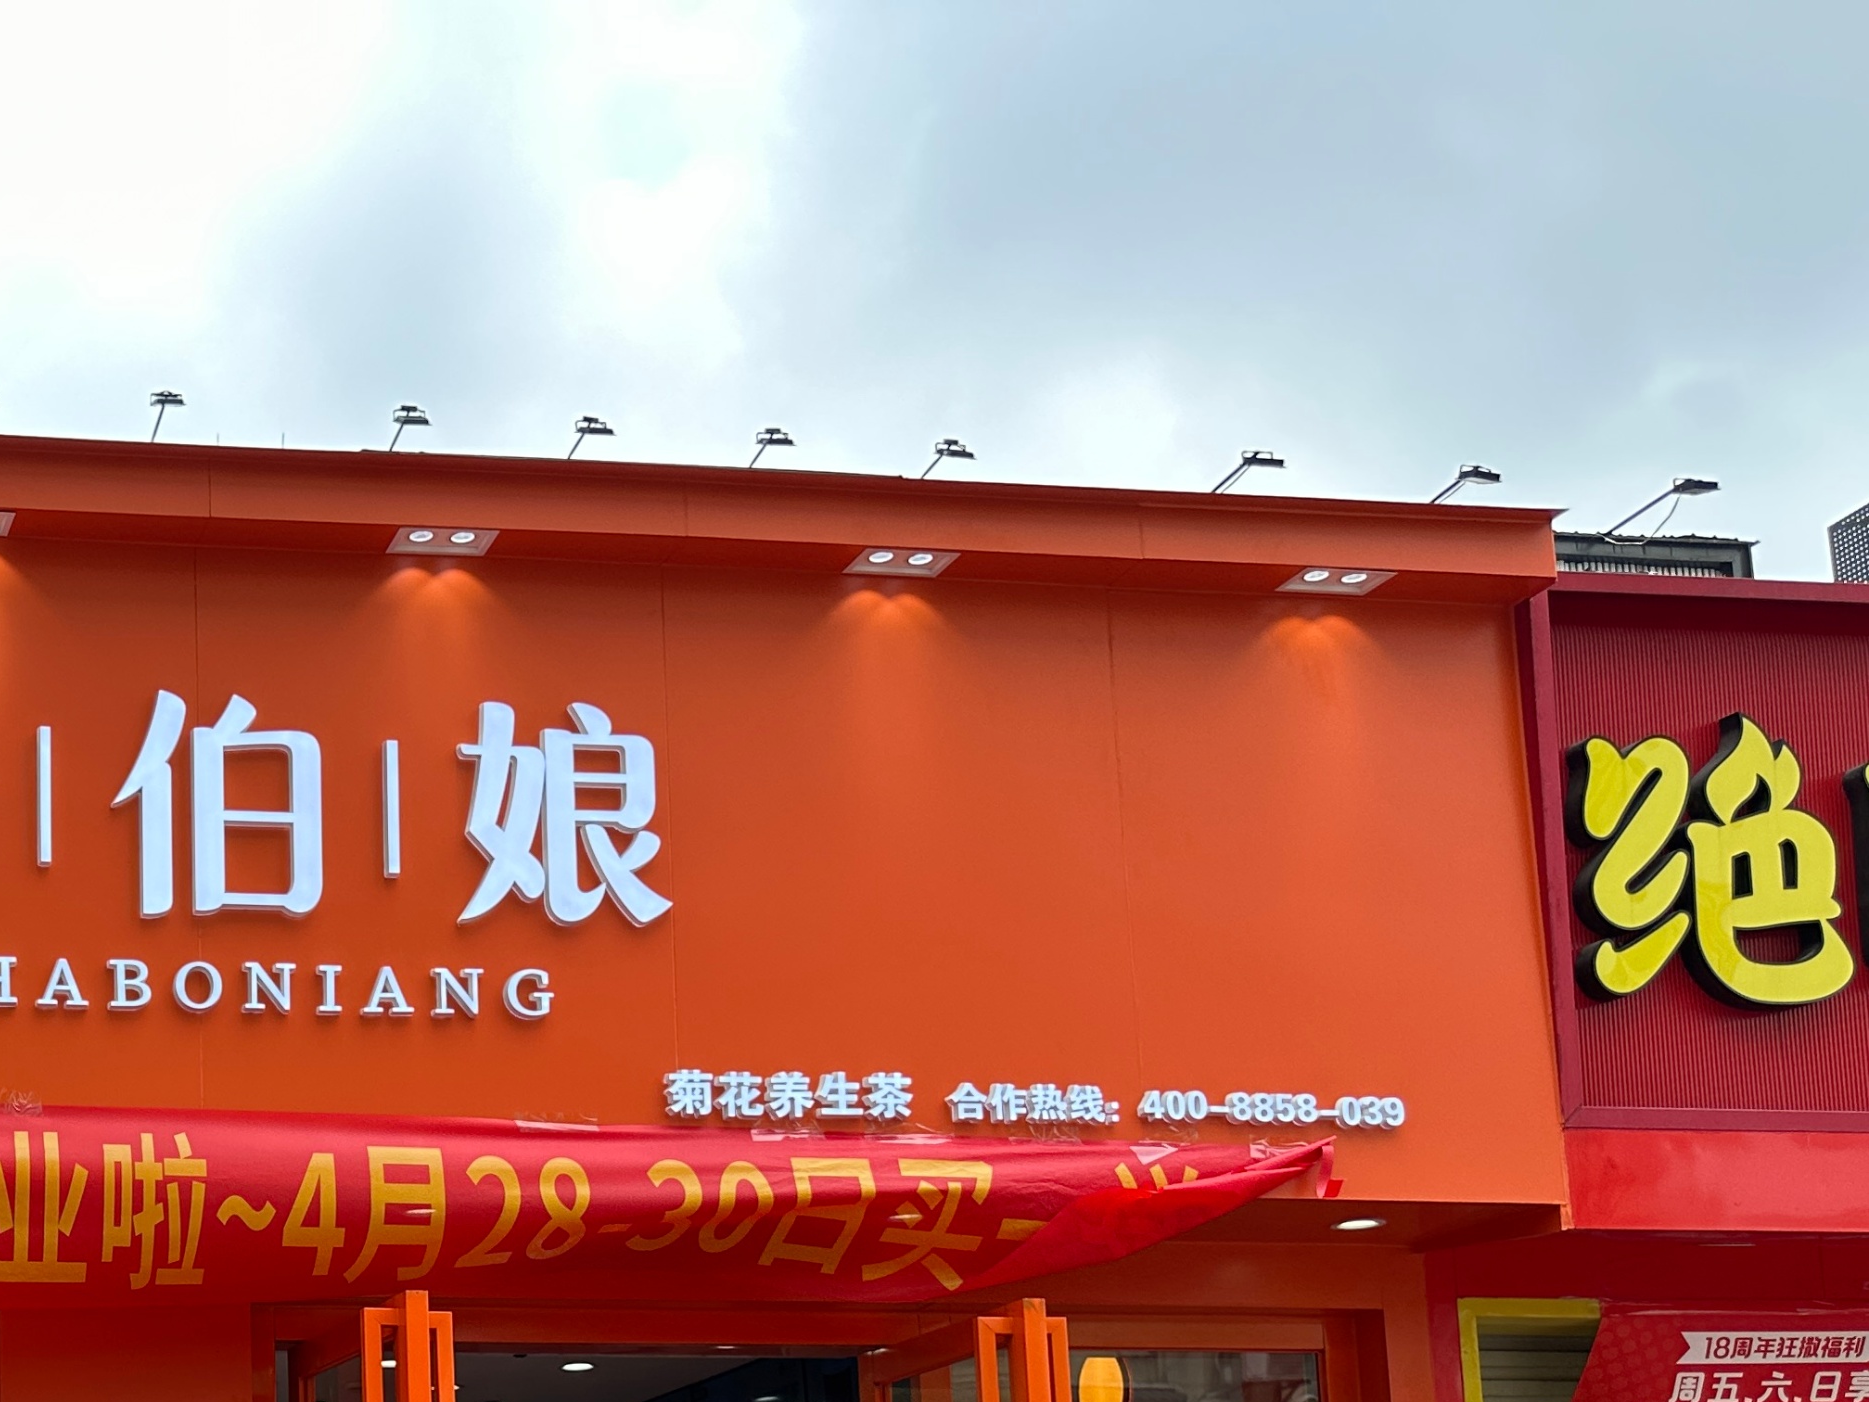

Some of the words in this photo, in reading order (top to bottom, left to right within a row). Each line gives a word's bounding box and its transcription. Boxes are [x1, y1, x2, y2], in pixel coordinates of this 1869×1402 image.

[1568, 712, 1869, 1007] 绝
[664, 1068, 914, 1120] 菊花养生茶
[1136, 1088, 1408, 1131] 400-8858-039
[1704, 1336, 1866, 1360] 18周年狂撒福利
